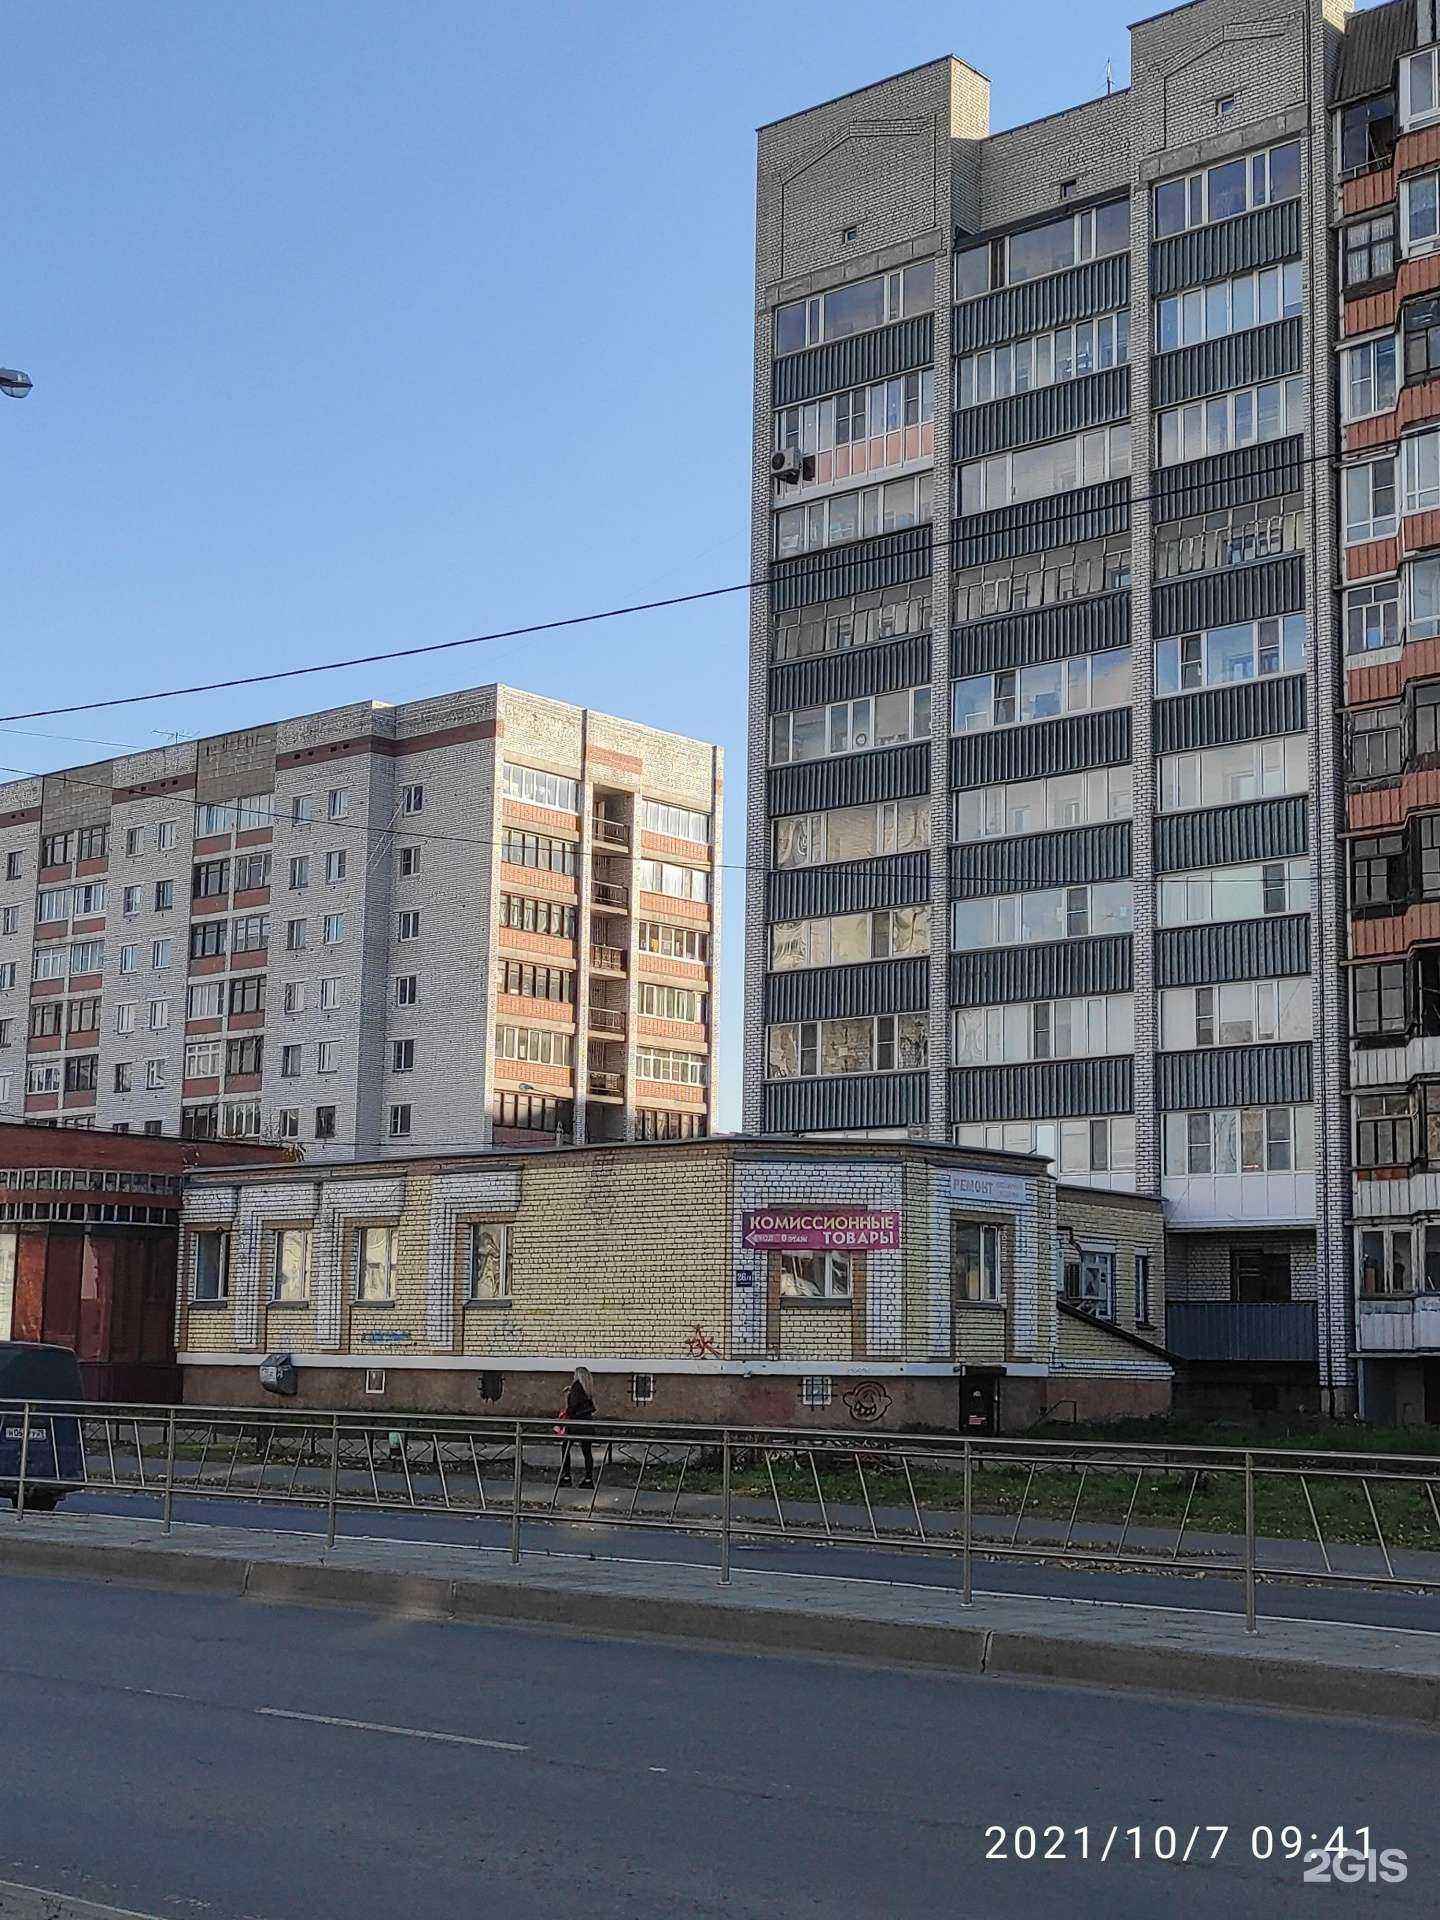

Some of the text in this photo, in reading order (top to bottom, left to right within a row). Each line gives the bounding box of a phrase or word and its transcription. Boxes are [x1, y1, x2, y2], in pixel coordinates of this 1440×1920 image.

[953, 1178, 993, 1195] РЕМОНТ
[750, 1216, 894, 1230] КОМИССИОННЫЕ
[822, 1231, 894, 1245] ТОВАРЫ
